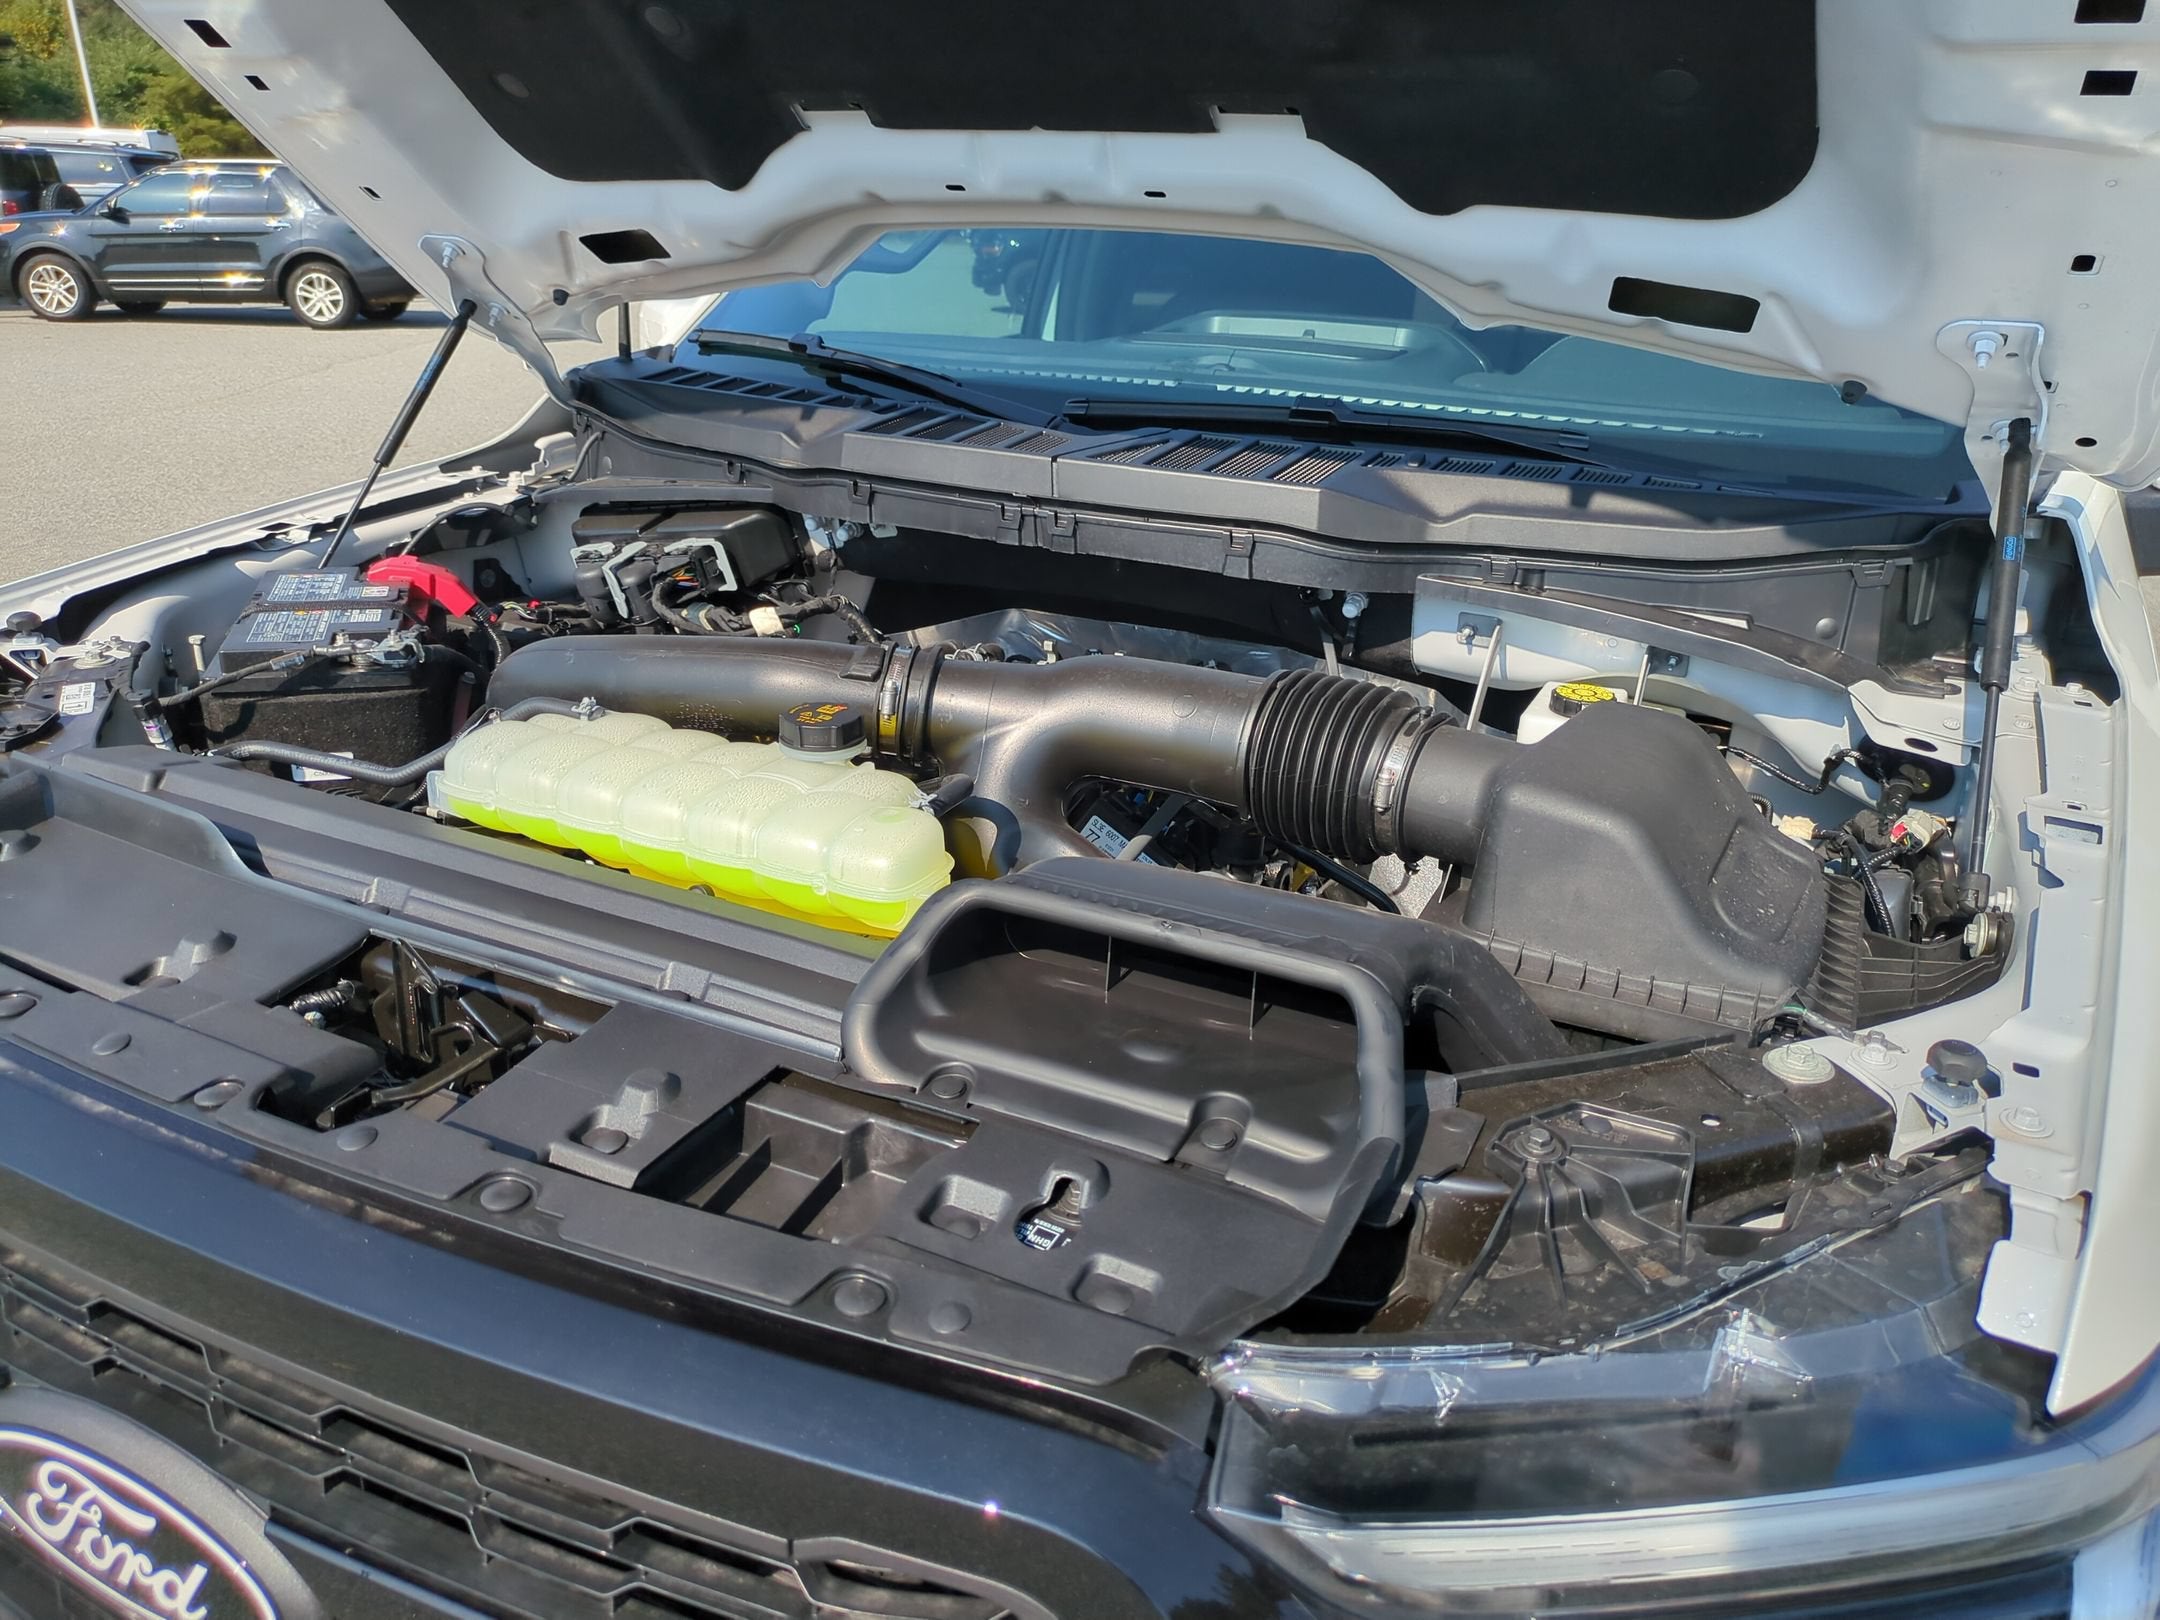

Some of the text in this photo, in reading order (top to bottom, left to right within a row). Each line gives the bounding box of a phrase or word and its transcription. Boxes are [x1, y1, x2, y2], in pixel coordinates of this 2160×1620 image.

[1086, 829, 1100, 842] 77
[1028, 1234, 1051, 1247] GHN
[27, 1461, 208, 1620] Ford
